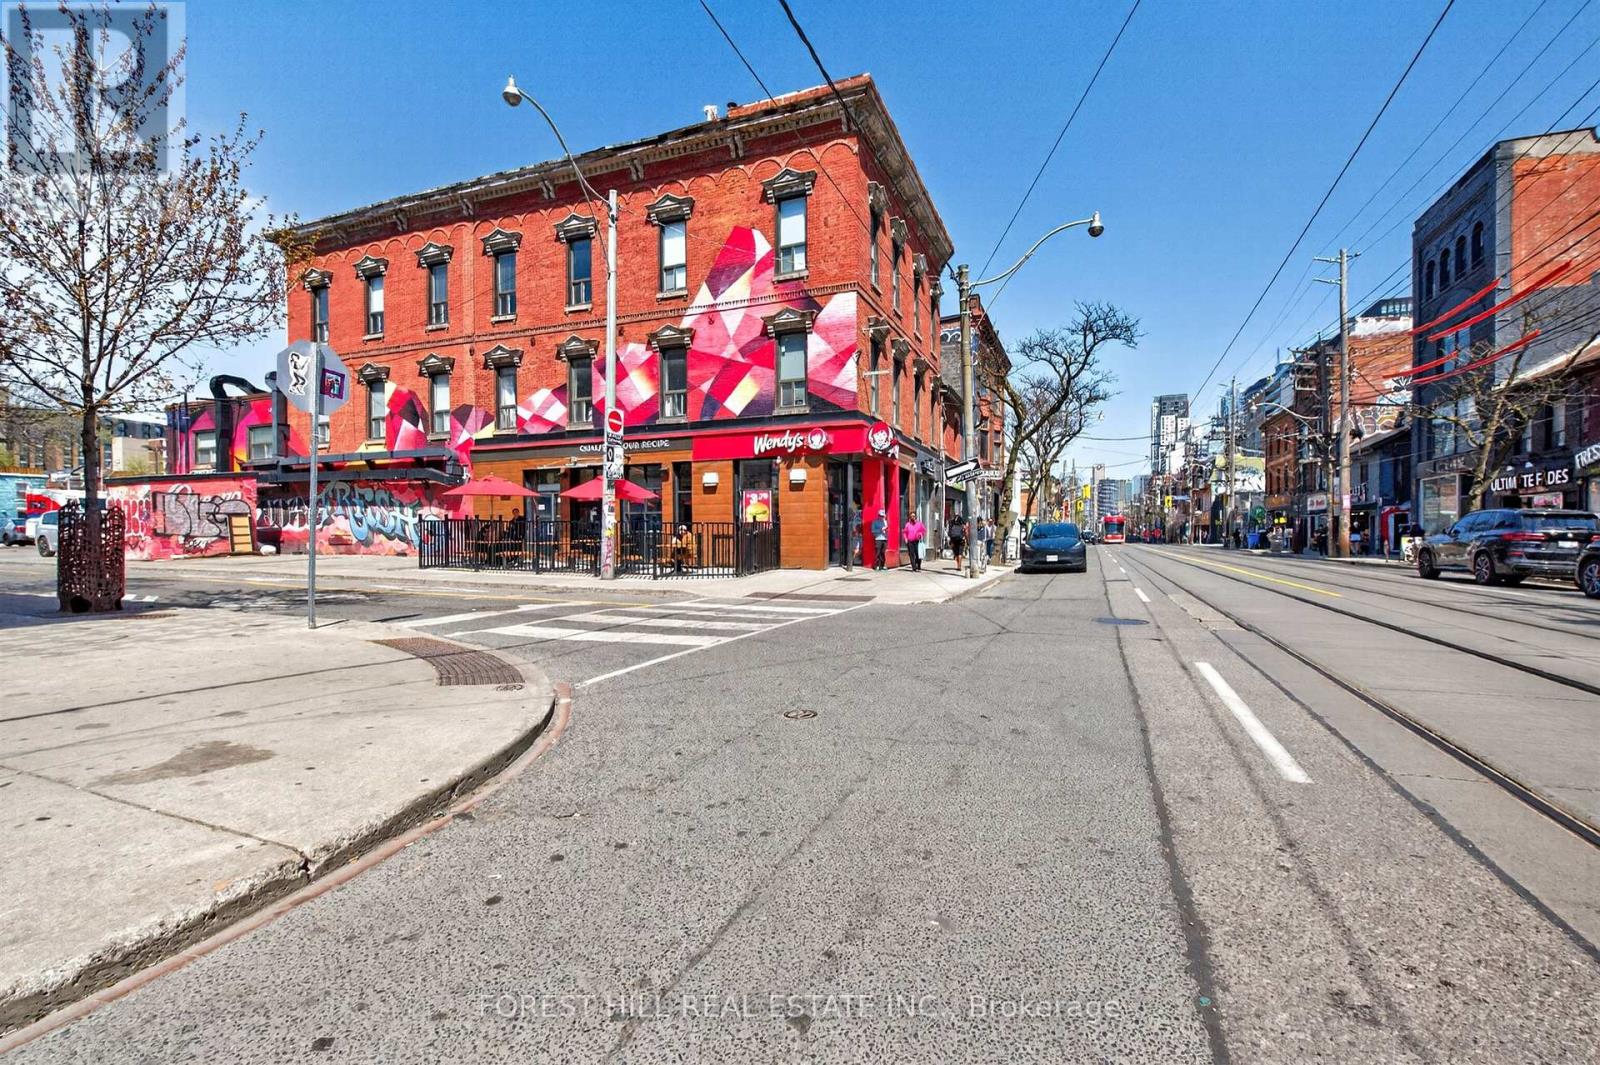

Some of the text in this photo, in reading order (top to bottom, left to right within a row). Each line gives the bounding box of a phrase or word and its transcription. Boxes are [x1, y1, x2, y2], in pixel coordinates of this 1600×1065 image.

[641, 439, 670, 449] RECIPE
[753, 429, 804, 455] Wendy's
[1491, 468, 1569, 491] ULTIMTE FDES
